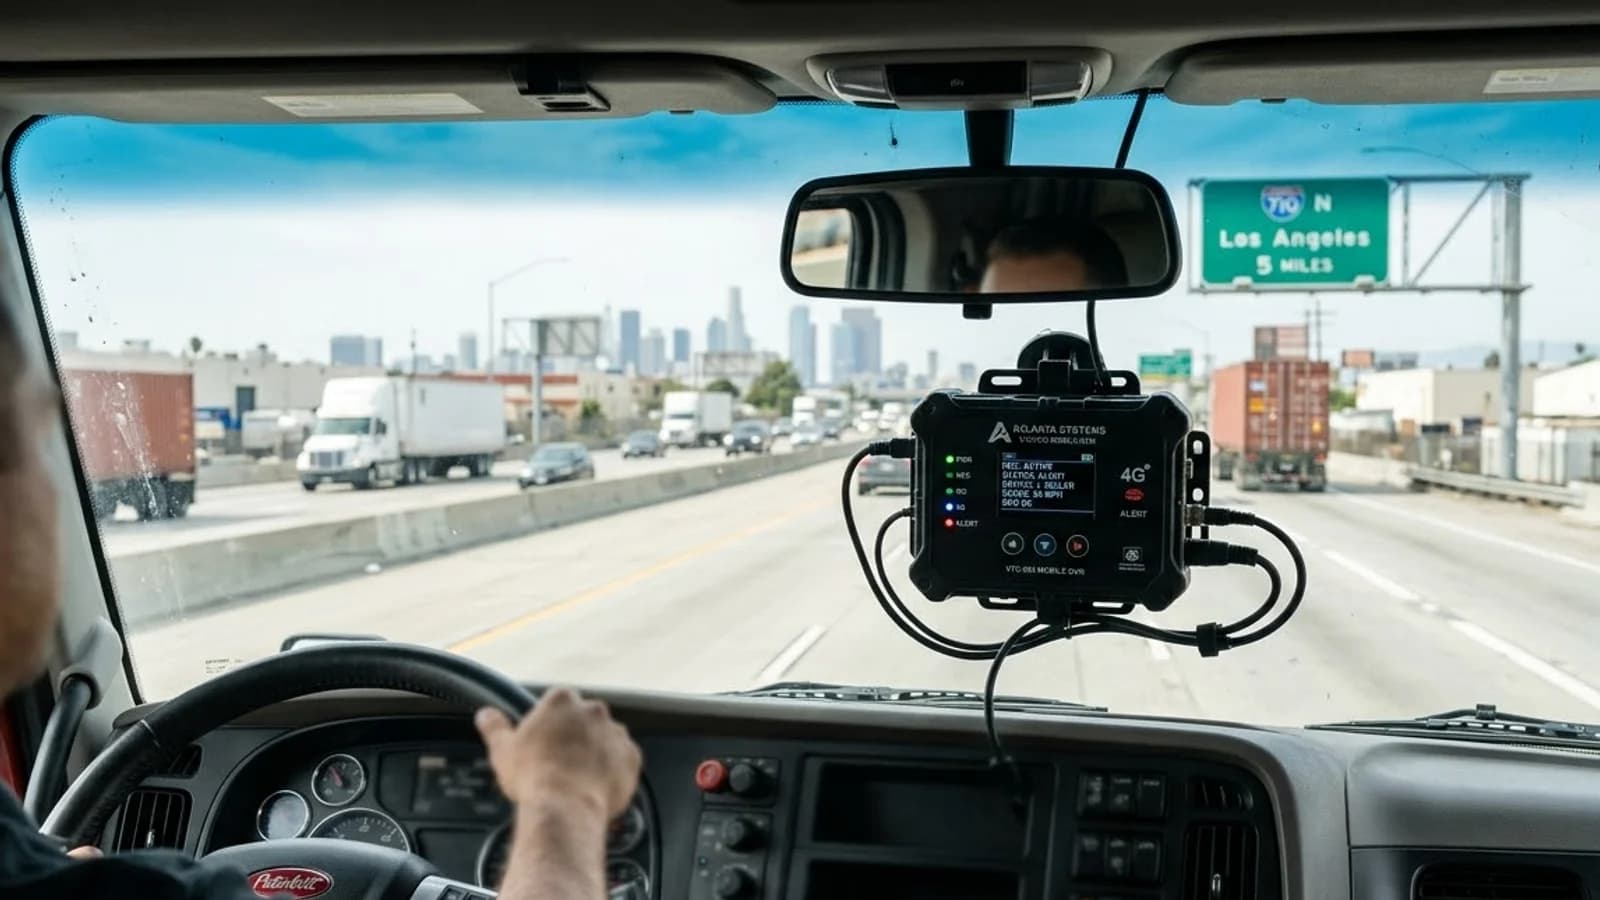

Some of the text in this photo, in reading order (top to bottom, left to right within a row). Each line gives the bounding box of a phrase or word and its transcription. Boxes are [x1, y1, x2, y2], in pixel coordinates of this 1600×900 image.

[1267, 194, 1332, 215] 710 N
[1219, 228, 1371, 251] Los Angeles
[1256, 254, 1334, 275] 5 MILES
